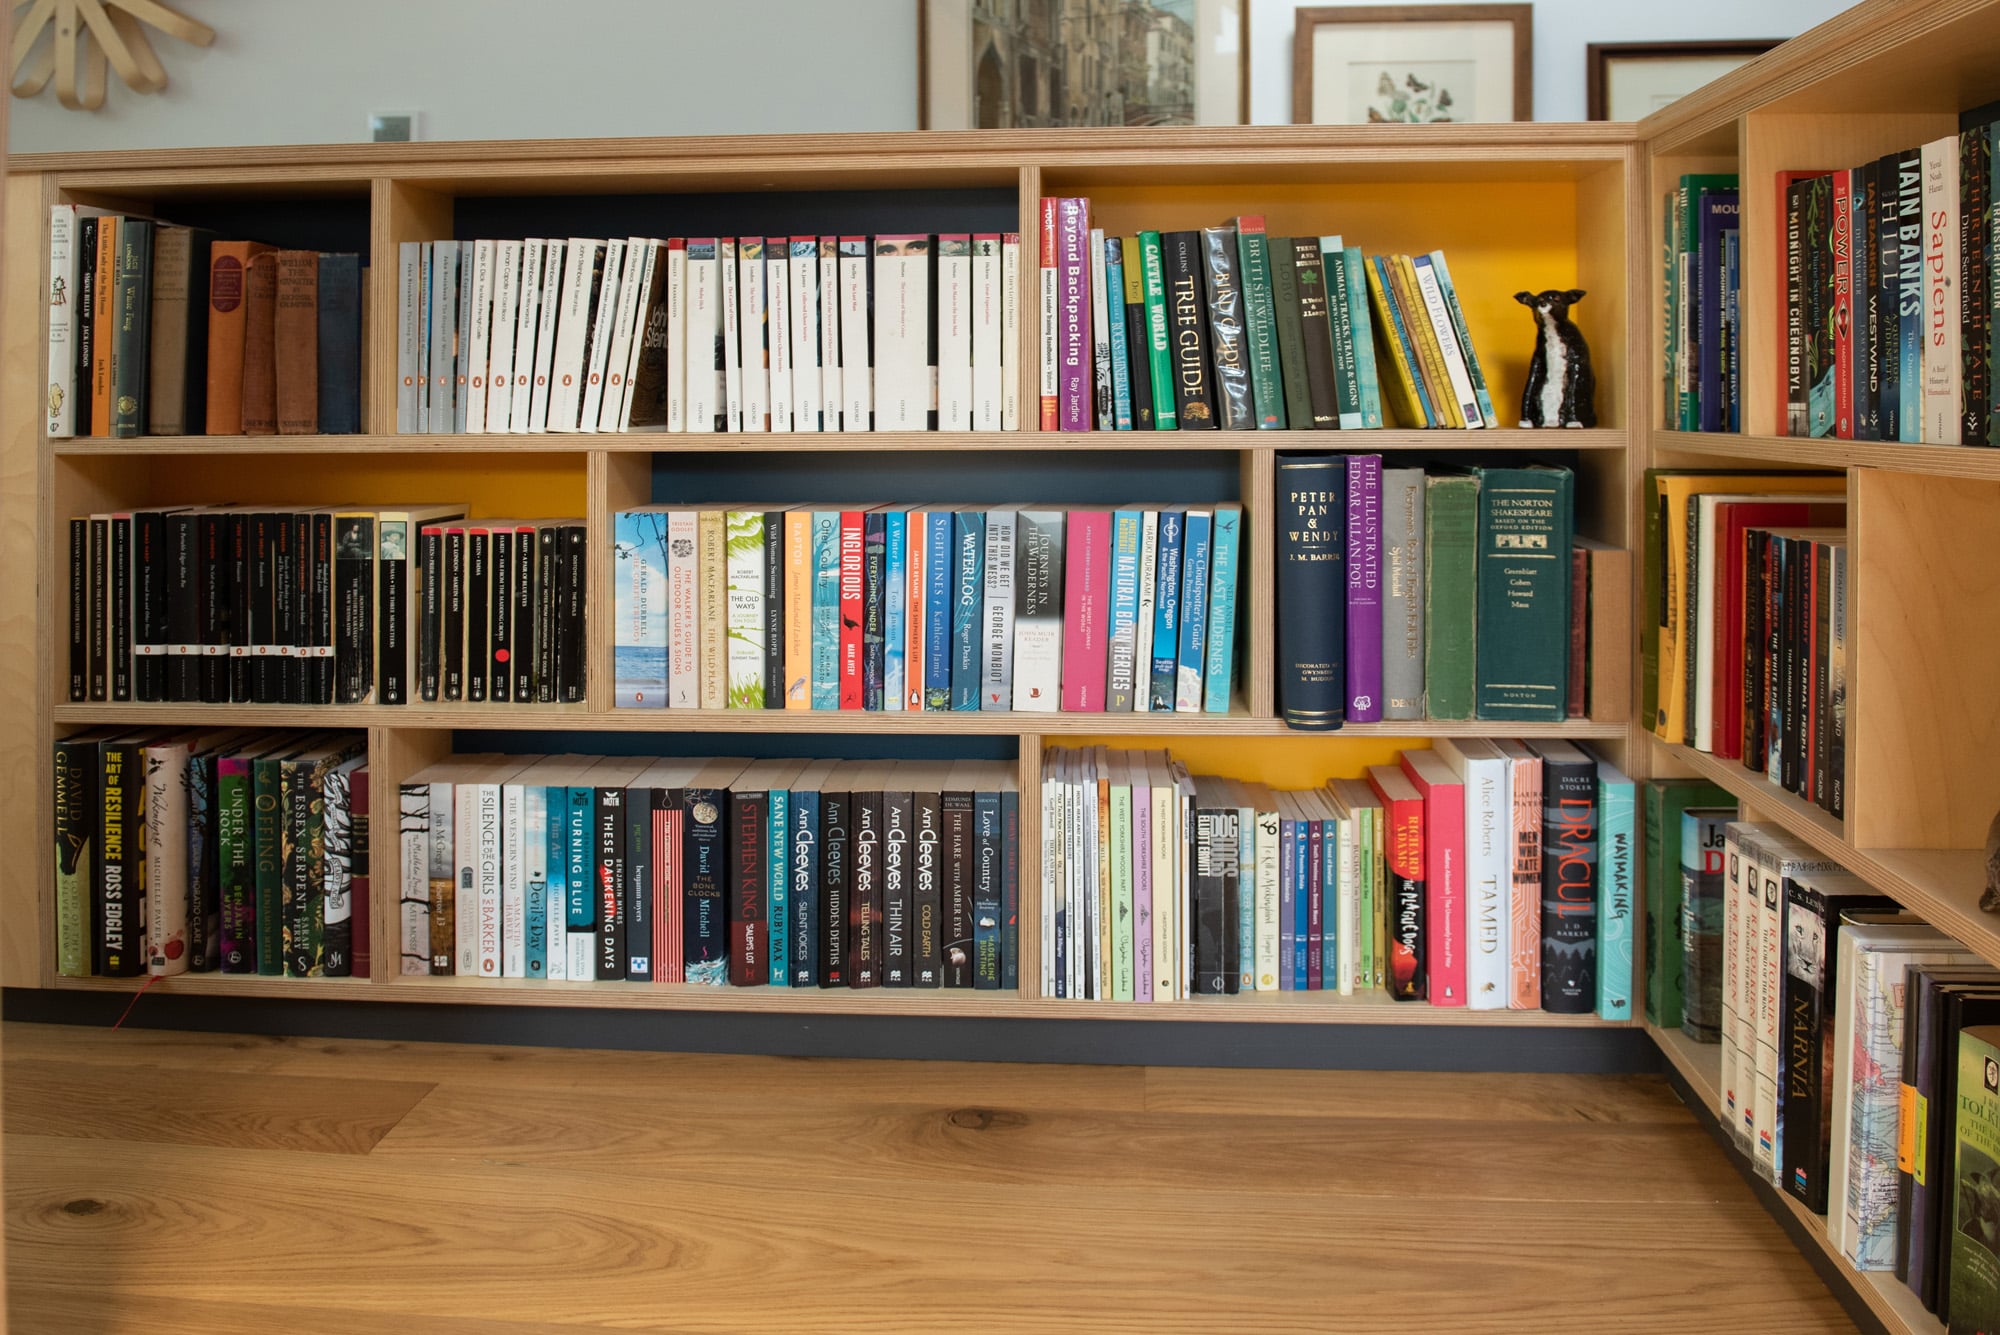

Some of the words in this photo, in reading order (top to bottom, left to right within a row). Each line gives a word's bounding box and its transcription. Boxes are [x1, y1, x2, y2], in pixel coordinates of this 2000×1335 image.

[1866, 182, 1876, 214] IAN
[1899, 159, 1921, 217] IAIN
[1066, 205, 1080, 262] Beyond
[1788, 212, 1800, 282] MIDNIGHT
[1836, 197, 1848, 295] POWER
[1881, 200, 1898, 290] HILL
[1961, 215, 1969, 252] Diane
[1971, 173, 1981, 328] THIRTEENTH
[527, 259, 536, 287] Steinbeck
[1146, 244, 1162, 296] CATTLE
[1179, 242, 1188, 272] COLLINS
[1249, 239, 1265, 303] BRITISH
[1867, 222, 1877, 287] RANKIN
[1899, 224, 1921, 317] BANKS
[1335, 259, 1346, 300] ANIMALS:
[1788, 288, 1800, 302] IN
[1926, 210, 1947, 347] Sapiens
[1961, 256, 1970, 324] Setterfield
[1066, 266, 1081, 366] Backpacking
[1175, 275, 1197, 326] TREE
[1339, 302, 1350, 338] TRACKS,
[1422, 273, 1438, 309] WILD
[1432, 307, 1455, 357] FLOWERS
[1151, 304, 1167, 351] WORLD
[1255, 305, 1272, 372] WILDLIFE
[1869, 295, 1878, 393] WESTWIND
[1179, 330, 1203, 397] GUIDE
[1344, 340, 1353, 370] TRAILS
[1789, 308, 1801, 393] CHERNOBYL
[1069, 377, 1079, 392] Ray
[1971, 341, 1983, 401] TALE
[1070, 394, 1080, 423] Jardine
[1348, 380, 1358, 406] SIGNS
[1350, 461, 1361, 506] EDGAR
[1365, 461, 1376, 490] THE
[1291, 492, 1335, 503] PETER
[1298, 505, 1327, 516] PAN
[1490, 509, 1553, 517] SHAKESPEARE
[1145, 525, 1153, 554] HARUKI
[1289, 531, 1338, 542] WENDY
[1307, 518, 1317, 529] &
[1350, 513, 1361, 558] ALLAN
[1365, 495, 1376, 588] ILLUSTRATED
[842, 527, 861, 600] INGLORIOUS
[934, 519, 947, 595] SIGHTLINES
[1197, 541, 1206, 557] The
[1215, 544, 1228, 567] THE
[769, 566, 777, 599] Swimming
[869, 556, 877, 603] EVERYTHING
[961, 532, 976, 606] WATERLOG
[1116, 556, 1135, 608] NATURAL
[1144, 556, 1152, 596] MURAKAMI
[1166, 548, 1178, 598] Washington,
[1214, 571, 1227, 599] LAST
[1350, 563, 1361, 588] POE
[735, 602, 755, 610] WAYS
[1193, 560, 1206, 621] Cloudspotter's
[869, 605, 877, 632] UNDER
[933, 611, 944, 651] Kathleen
[961, 623, 970, 643] Roger
[992, 606, 1003, 639] GEORGE
[1114, 611, 1133, 642] BORN
[1164, 599, 1175, 629] Oregon
[847, 643, 856, 658] MARK
[1191, 624, 1202, 650] Guide
[1211, 604, 1225, 675] WILDERNESS
[685, 661, 692, 672] TO
[847, 659, 856, 676] AVERY
[932, 653, 943, 678] Jamie
[962, 645, 971, 670] Deakin
[991, 643, 1003, 683] MONBIOT
[1112, 646, 1131, 690] HEROES
[57, 751, 68, 837] GEMMELL
[1481, 777, 1494, 806] Alice
[105, 787, 122, 860] RESILIENCE
[219, 809, 230, 846] ROCK
[231, 788, 245, 835] UNDER
[295, 795, 306, 838] ESSEX
[483, 797, 495, 846] SILENCE
[774, 796, 784, 827] SANE
[891, 806, 901, 828] Ann
[1198, 815, 1210, 844] ELLIOTT
[1210, 815, 1238, 837] DOG
[571, 809, 583, 874] TURNING
[603, 814, 614, 853] THESE
[742, 804, 757, 877] STEPHEN
[774, 830, 784, 859] NEW
[1397, 825, 1407, 868] ADAMS
[1409, 816, 1419, 875] RICHARD
[1481, 811, 1494, 857] Roberts
[1518, 845, 1538, 857] WHO
[1519, 831, 1538, 843] MEN
[232, 840, 245, 867] THE
[699, 845, 710, 873] David
[886, 828, 907, 890] Cleeves
[1198, 846, 1210, 877] ERWITT
[1518, 859, 1538, 871] HATE
[1557, 798, 1592, 919] DRACUL
[105, 865, 122, 899] ROSS
[295, 846, 307, 912] SERPENT
[483, 861, 495, 895] GIRLS
[603, 859, 614, 933] DARKENING
[773, 862, 784, 901] WORLD
[1512, 872, 1541, 884] WOMEN
[1609, 833, 1629, 920] WAYMAKING
[529, 881, 545, 921] Devil's
[572, 880, 583, 915] BLUE
[740, 880, 757, 918] KING
[830, 890, 839, 927] HIDDEN
[889, 899, 902, 931] THIN
[1398, 892, 1420, 931] PLAGUE
[1480, 874, 1497, 954] TAMED
[105, 902, 122, 950] EDGLEY
[483, 907, 494, 953] BARKER
[699, 898, 710, 937] Mitchell
[774, 905, 783, 934] RUBY
[527, 925, 543, 950] Day
[604, 937, 614, 969] DAYS
[774, 938, 783, 962] WAX
[830, 929, 839, 966] DEPTHS
[889, 933, 902, 956] AIR
[1399, 933, 1417, 955] DOGS
[1767, 959, 1777, 1036] TOLKIEN
[1791, 996, 1809, 1098] NARNIA
